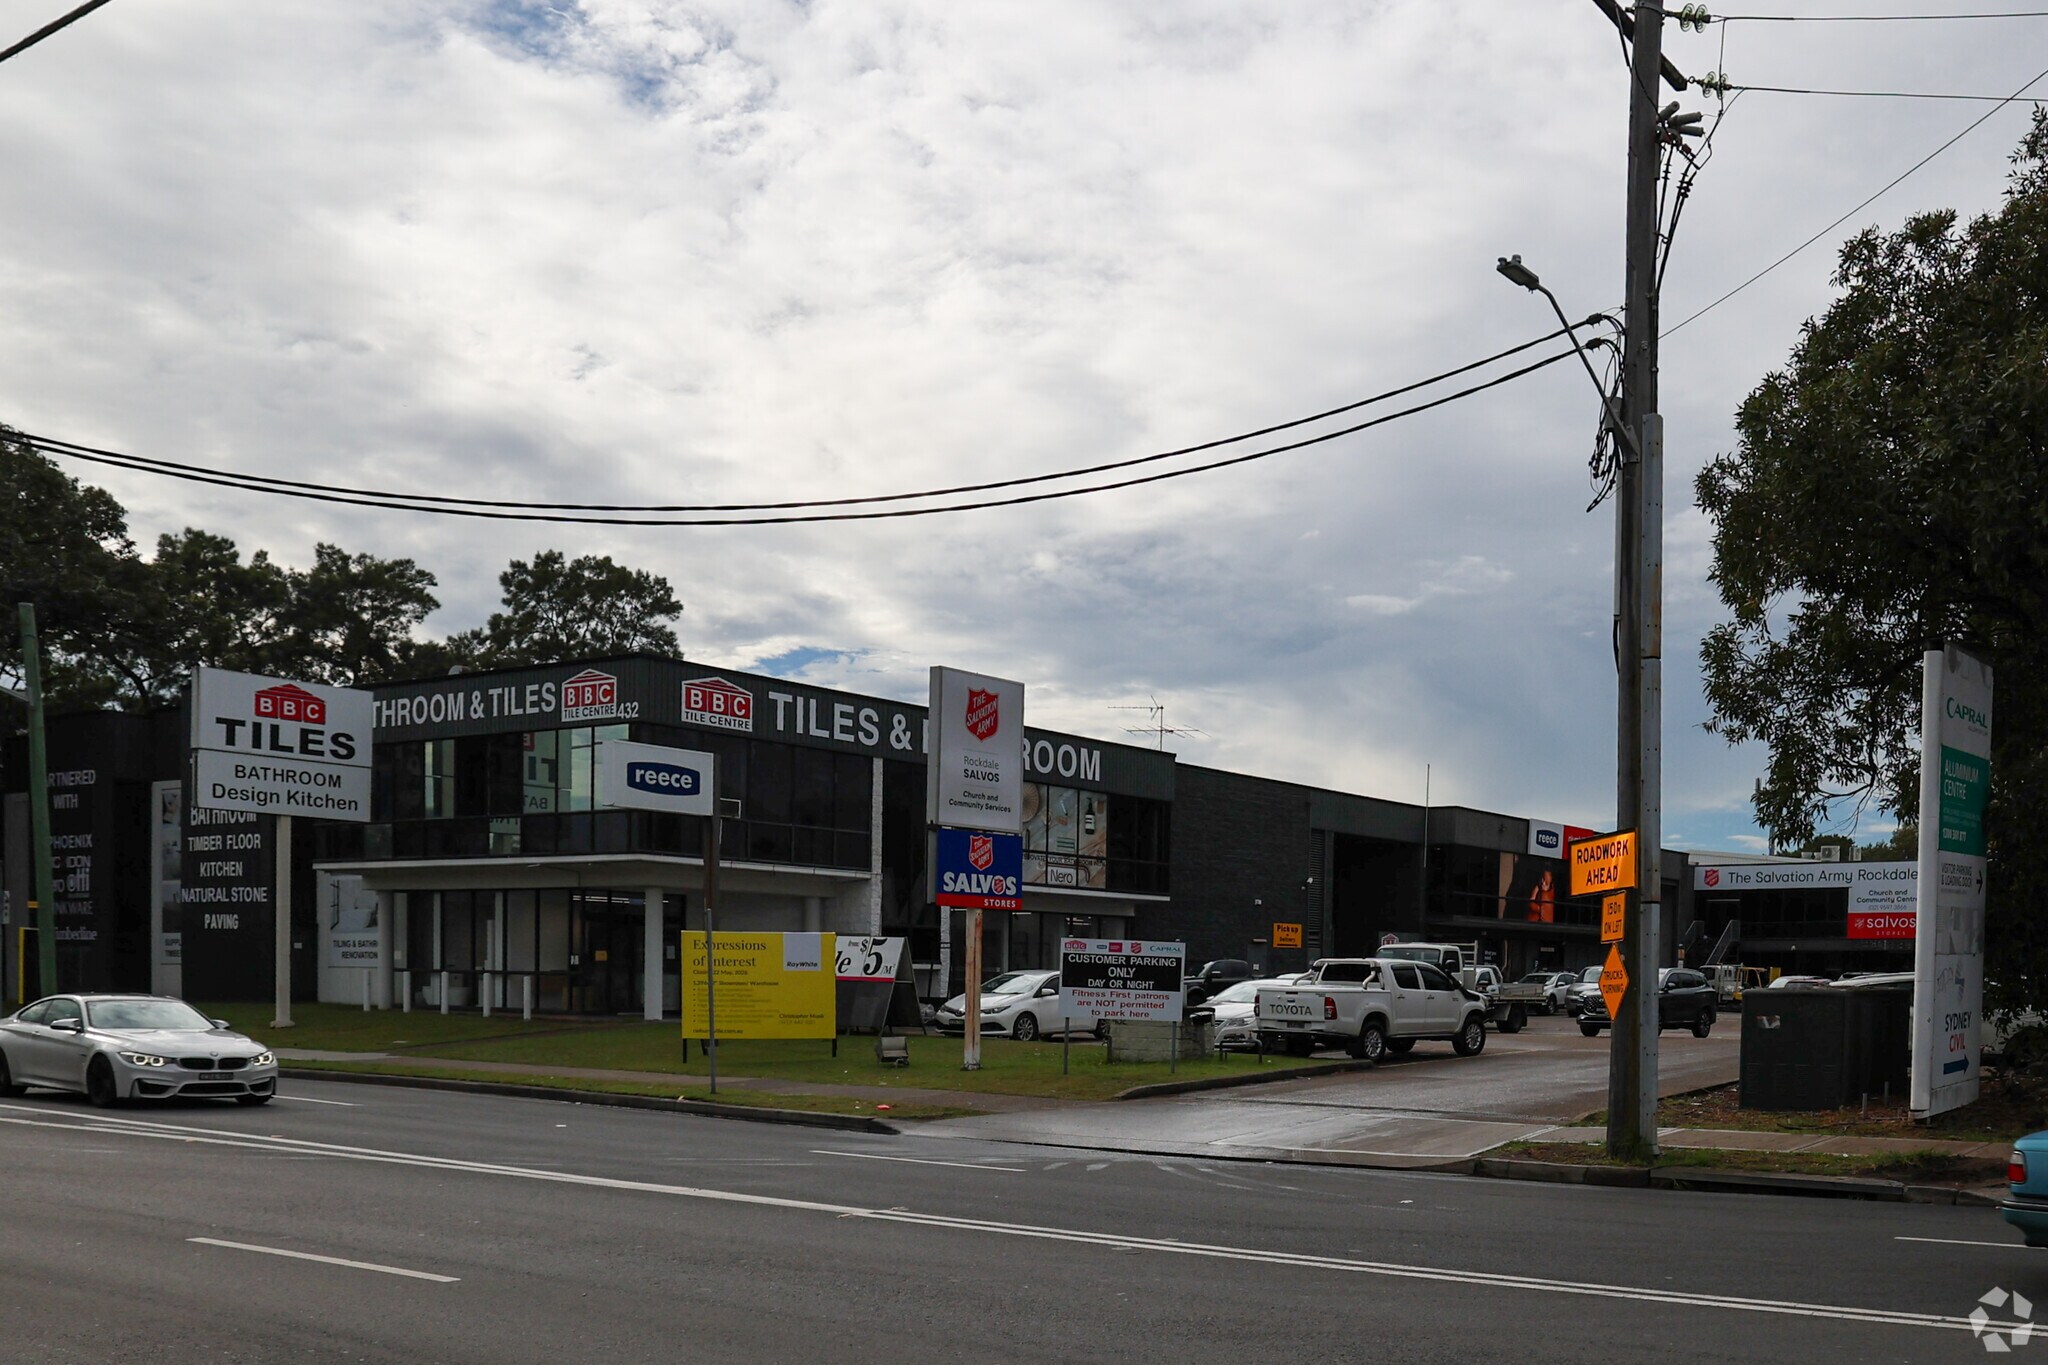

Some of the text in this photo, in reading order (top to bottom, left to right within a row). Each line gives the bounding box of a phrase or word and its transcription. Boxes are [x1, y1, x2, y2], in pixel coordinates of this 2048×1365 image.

[469, 690, 485, 720] &
[488, 682, 557, 717] TILES
[567, 684, 612, 707] BBC
[690, 690, 747, 717] BBC
[259, 697, 321, 721] BBC
[563, 703, 616, 719] TILE CENTRE
[617, 701, 639, 719] 432
[1946, 697, 1988, 729] CAPRAL
[684, 710, 751, 730] TILE CENTRE
[768, 691, 913, 750] TILES &
[977, 714, 996, 735] ARMY
[215, 717, 356, 760] TILES
[964, 756, 1000, 770] Rockdale
[234, 764, 342, 789] BATHROOM
[634, 768, 693, 789] reece
[963, 768, 1000, 783] SALVOS
[211, 783, 358, 812] Design Kitchen
[963, 790, 998, 802] Church and
[1944, 779, 1967, 800] CENTRE
[53, 793, 78, 809] WITH
[949, 799, 1012, 813] Community Services
[188, 833, 261, 851] TIMBER FLOOR
[1538, 833, 1557, 845] reece
[1576, 839, 1629, 865] ROADWORK
[200, 861, 243, 877] KITCHEN
[1050, 868, 1073, 884] Nero
[1585, 864, 1619, 887] AHEAD
[1728, 871, 1751, 884] The
[1755, 868, 1815, 884] Salvation
[1818, 868, 1853, 884] Army
[1857, 865, 1919, 881] Rockdale
[943, 871, 1017, 896] SALVOS
[181, 887, 267, 903] NATURAL STONE
[984, 898, 1016, 908] STORES
[1856, 896, 1895, 905] Community
[204, 914, 239, 929] PAVING
[1604, 919, 1623, 935] ON LEFT
[1866, 915, 1916, 928] salvos
[693, 956, 757, 967] of nterest
[1068, 954, 1177, 967] CUSTOMER PARKING
[1108, 966, 1136, 978] ONLY
[1603, 969, 1624, 981] TRUCKS
[1087, 978, 1155, 990] DAY OR NIGHT
[1602, 983, 1624, 994] TURNING
[1072, 989, 1170, 1001] Fitness First patrons
[1095, 999, 1117, 1008] NOT
[1120, 1001, 1165, 1011] permitted
[1269, 1003, 1313, 1016] TOYOTA
[1091, 1009, 1150, 1020] to park here
[1945, 1011, 1972, 1033] SYDNEY
[1949, 1033, 1967, 1054] CIVIL
